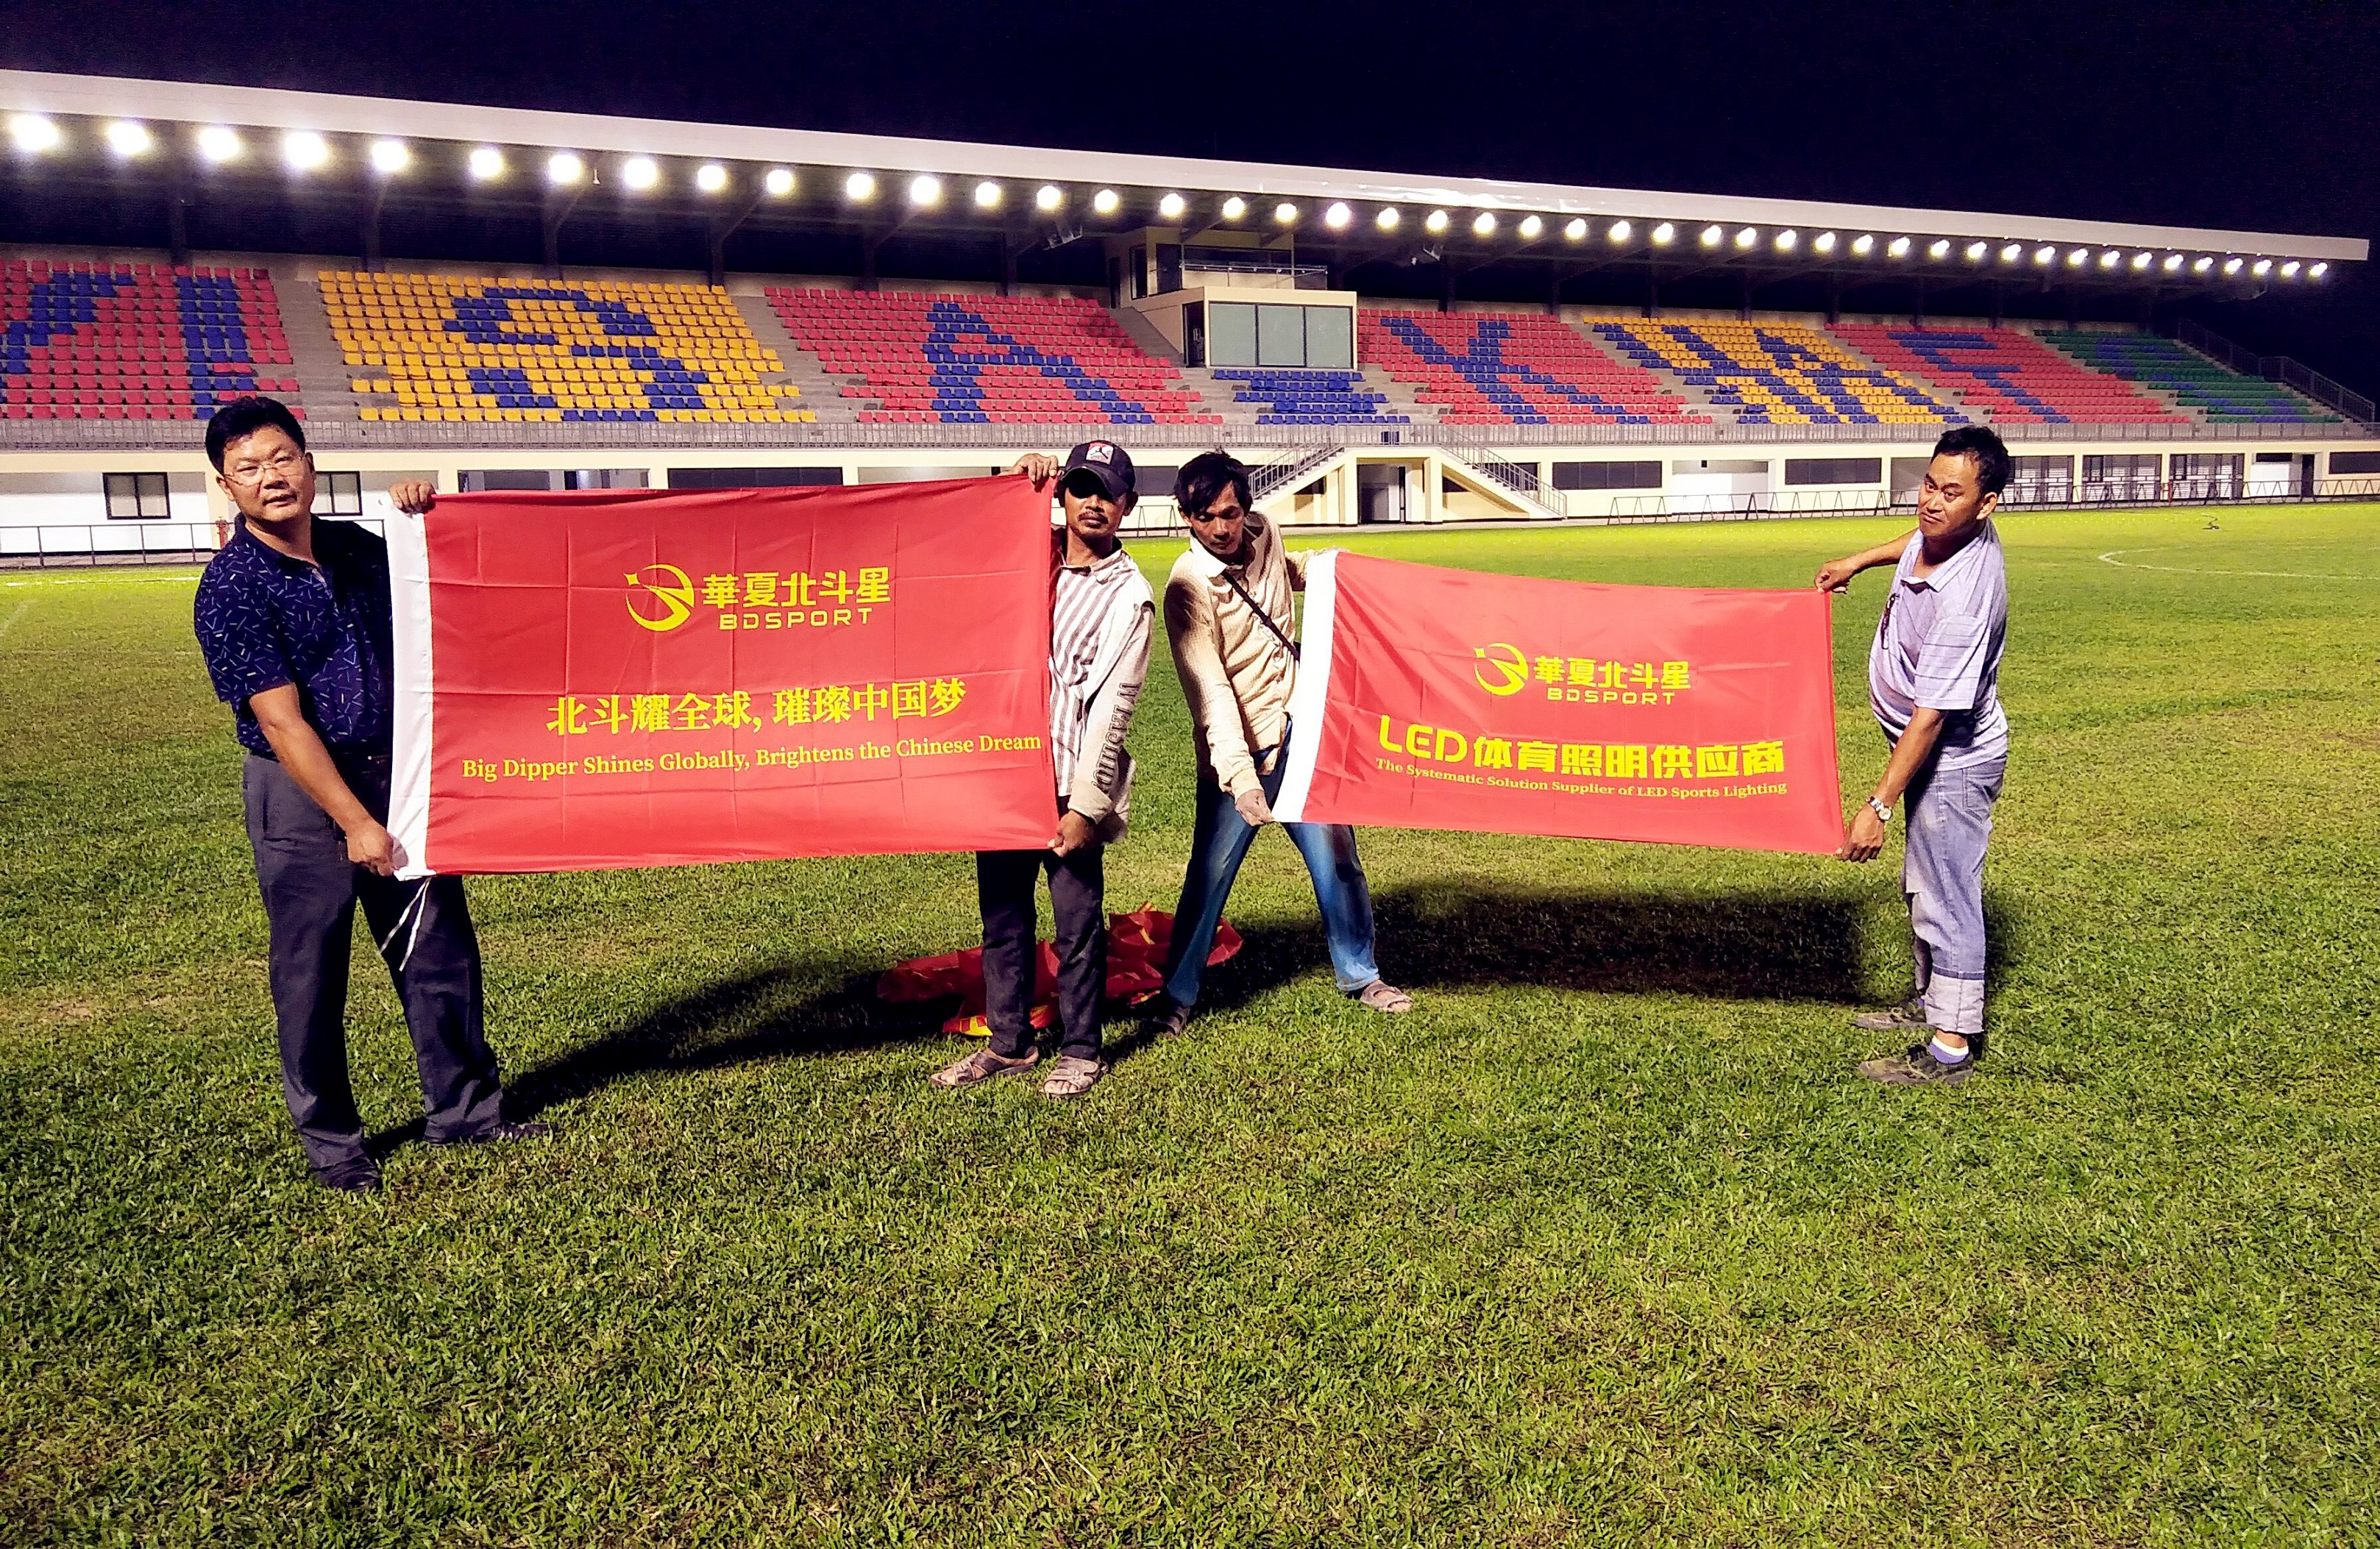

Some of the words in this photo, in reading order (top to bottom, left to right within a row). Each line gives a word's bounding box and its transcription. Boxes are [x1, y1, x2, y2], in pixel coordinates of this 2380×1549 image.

[701, 566, 891, 609] 華夏北斗星
[720, 608, 872, 630] BDSPORT
[1533, 655, 1691, 691] 華夏北斗星
[1546, 686, 1675, 705] BDSPORT
[462, 758, 497, 783] Big
[502, 758, 578, 782] Dipper
[583, 755, 655, 774] Shines
[658, 749, 750, 772] Globally,
[756, 746, 854, 769] Brightens
[859, 741, 891, 760] the
[895, 738, 974, 758] Chinese
[978, 735, 1042, 752] Dream
[1378, 714, 1469, 763] LED
[1472, 736, 1786, 780] 体育照明供应商
[1376, 758, 1404, 773] The
[1406, 765, 1484, 785] Systematic
[1487, 776, 1548, 791] Solution
[1552, 781, 1615, 795] Supplier
[1618, 785, 1634, 797] of
[1635, 786, 1669, 798] LED
[1671, 786, 1719, 800] Sports
[1723, 783, 1788, 800] Lighting
